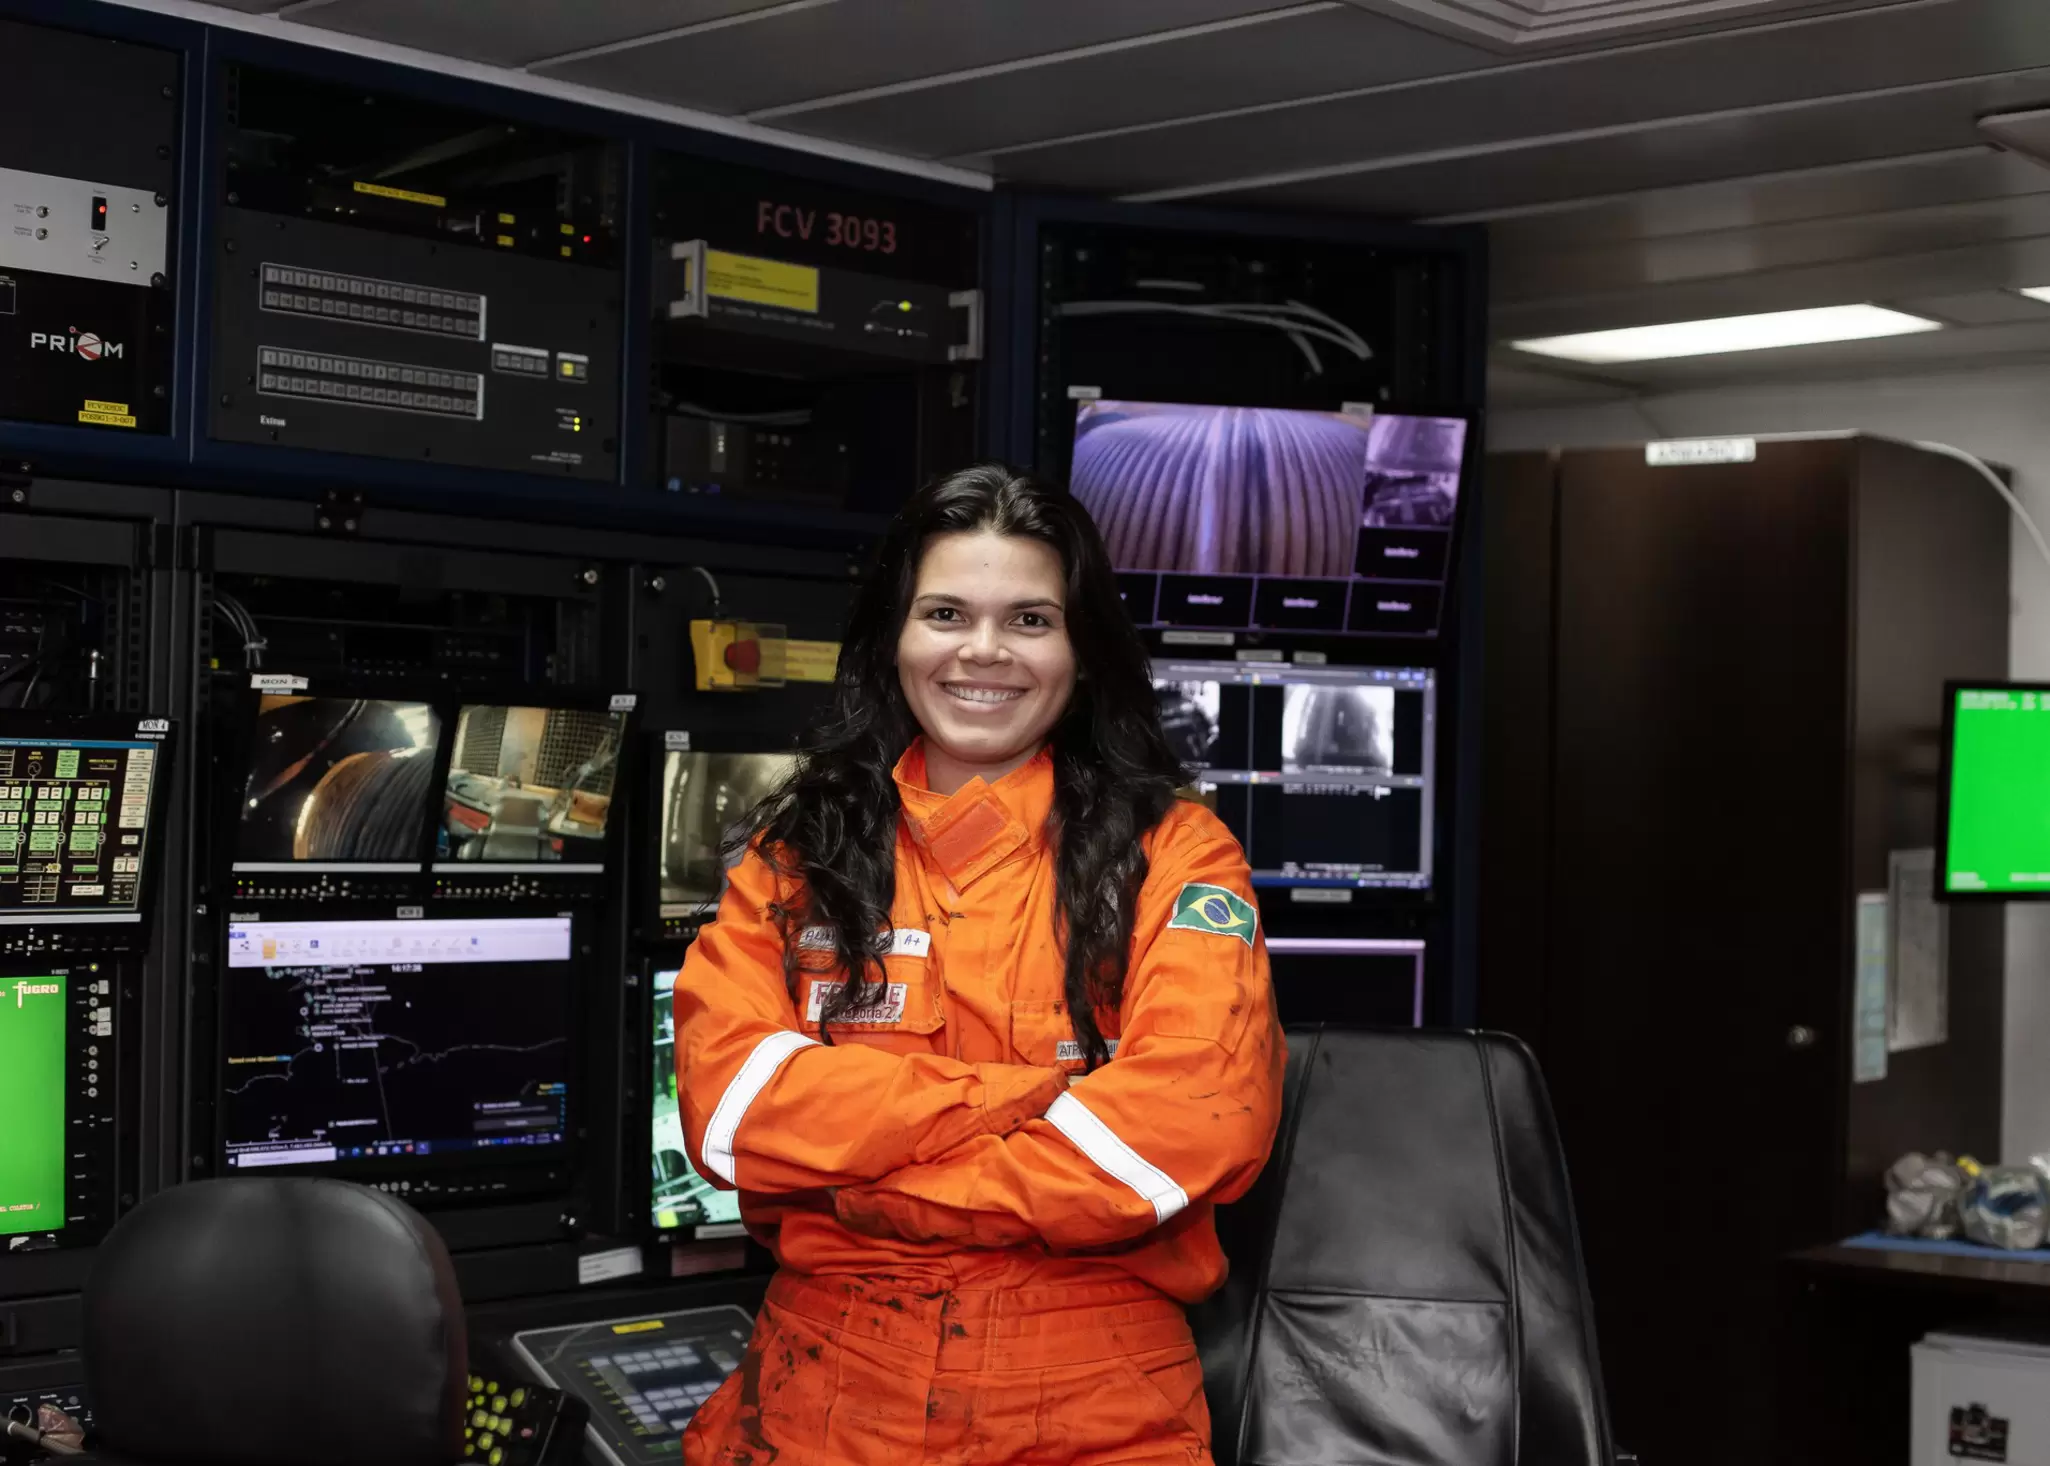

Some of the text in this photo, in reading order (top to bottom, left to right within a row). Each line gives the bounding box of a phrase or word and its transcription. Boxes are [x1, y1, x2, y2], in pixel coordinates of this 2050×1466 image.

[757, 200, 897, 255] FCV 3093
[142, 719, 159, 731] MON
[904, 934, 921, 946] A+
[884, 1006, 894, 1020] 2
